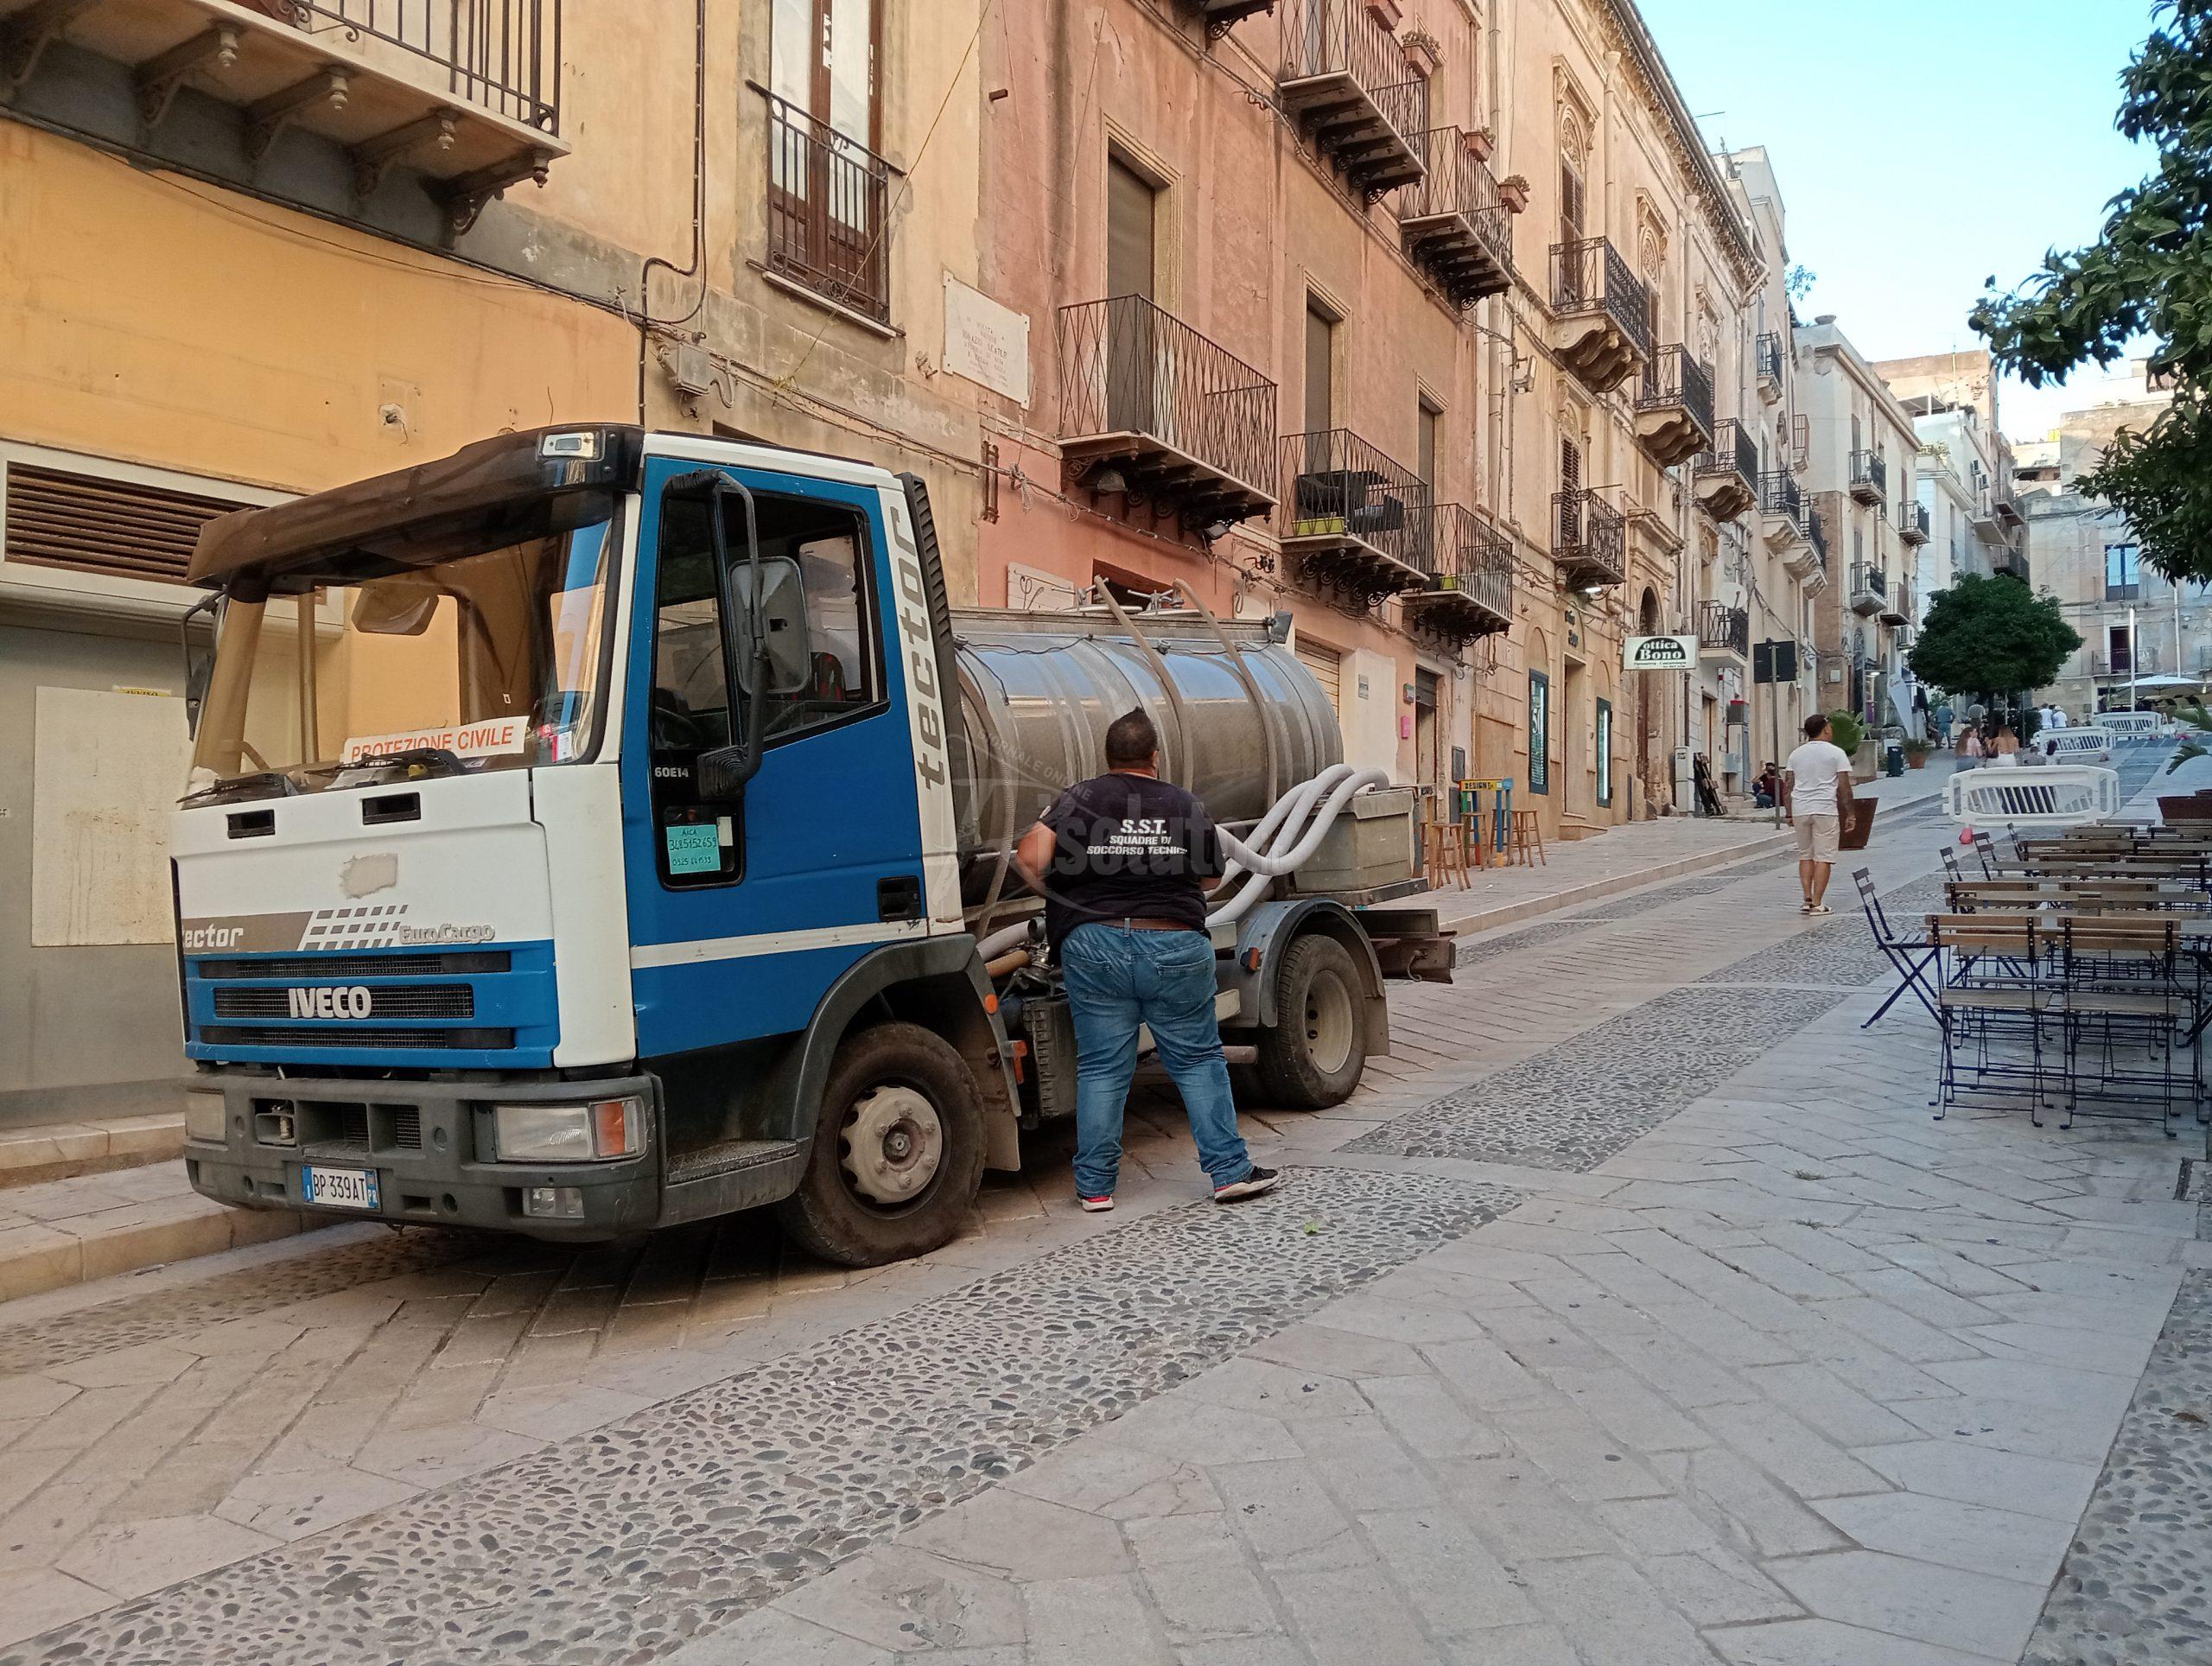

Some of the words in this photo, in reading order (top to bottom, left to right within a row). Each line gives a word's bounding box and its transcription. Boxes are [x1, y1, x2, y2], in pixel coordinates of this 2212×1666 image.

[890, 506, 944, 790] tector
[1643, 640, 1678, 650] ottica
[1639, 649, 1681, 660] Bono
[457, 725, 514, 750] CIVILE
[654, 766, 689, 778] 60E14
[1120, 818, 1167, 835] S.S.T.
[1109, 835, 1158, 846] SQUADRE
[1160, 836, 1172, 845] DI
[1086, 845, 1144, 855] SOCCORSO
[288, 985, 373, 1020] IVECO
